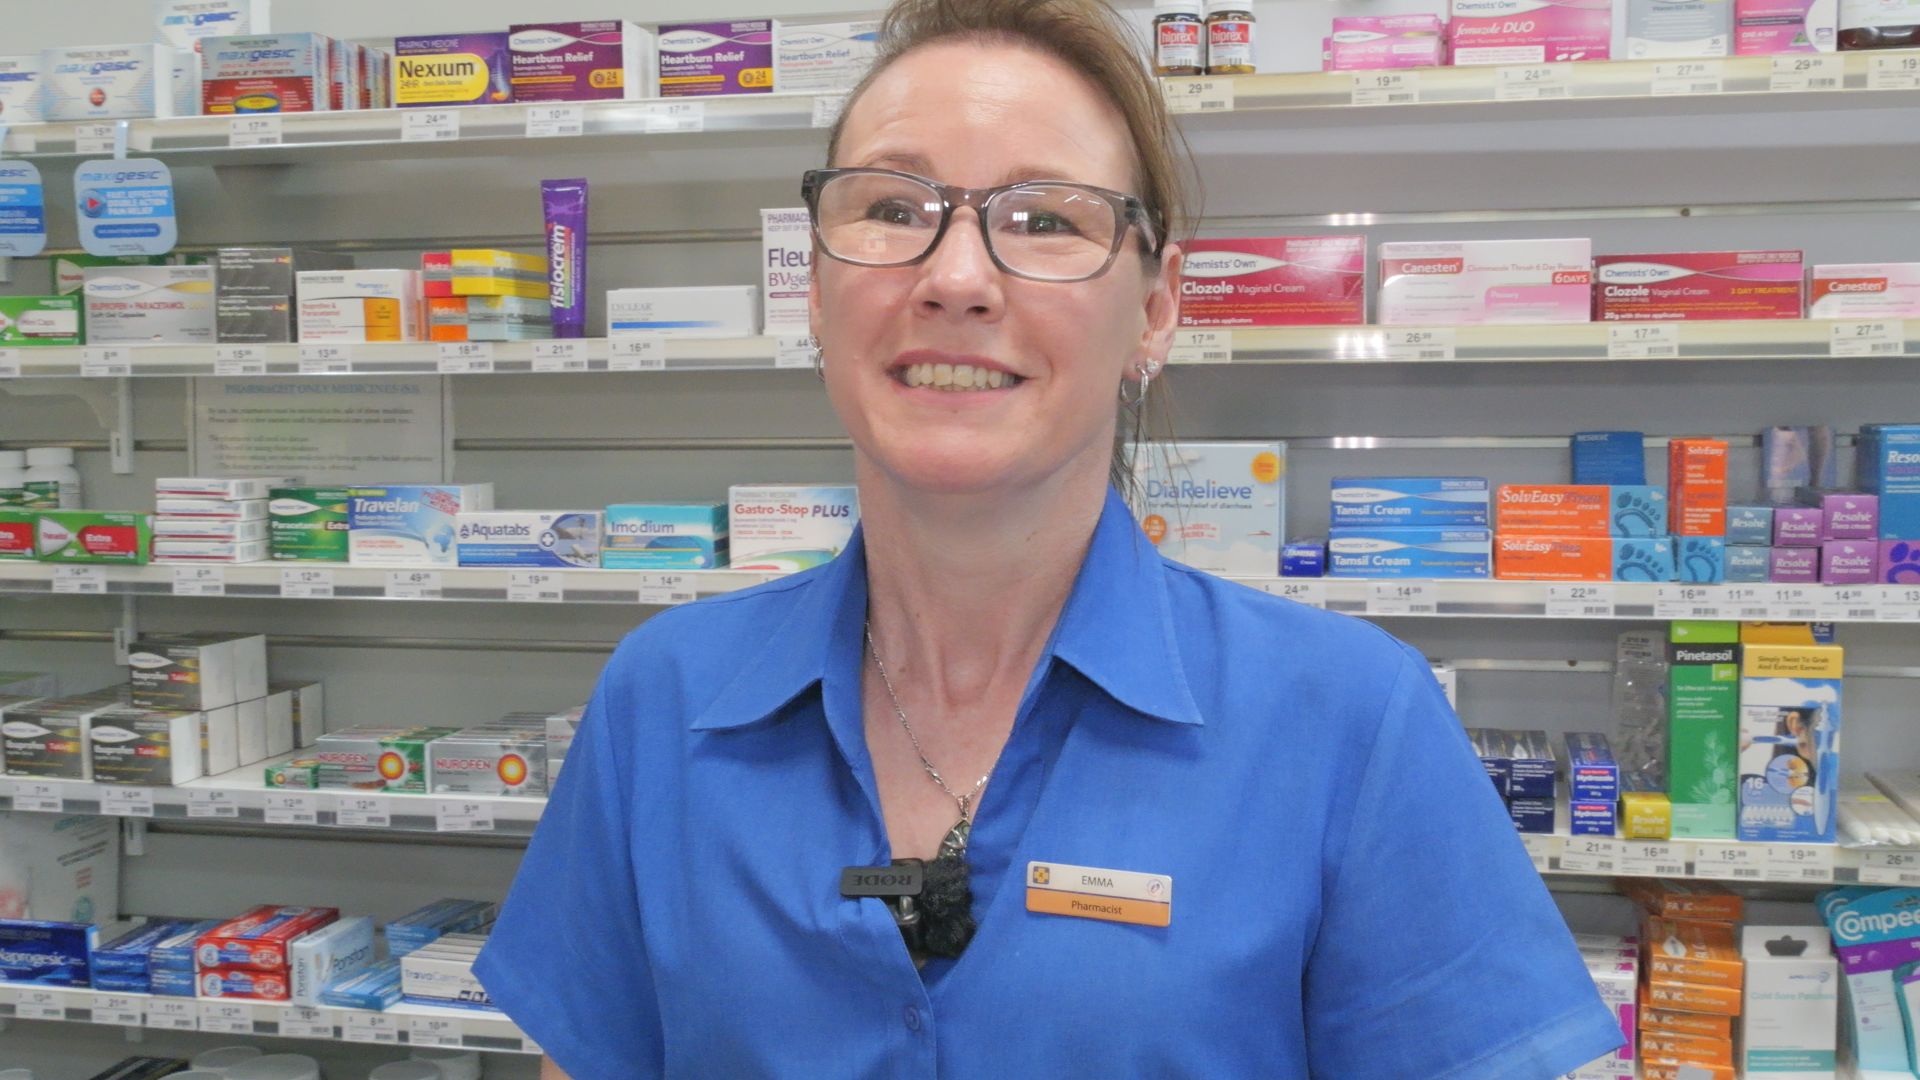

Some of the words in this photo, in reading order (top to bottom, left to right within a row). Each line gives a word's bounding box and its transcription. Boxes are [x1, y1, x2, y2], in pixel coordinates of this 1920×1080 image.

[1456, 1, 1496, 11] Chemists'
[1497, 1, 1518, 9] Own
[1503, 20, 1536, 34] DUO
[1161, 31, 1192, 45] hiprex
[1211, 31, 1243, 44] hiprex
[216, 49, 297, 62] maxigesic
[512, 53, 564, 65] Heartburn
[564, 51, 595, 63] Relief
[661, 53, 713, 65] Heartburn
[714, 50, 745, 63] Relief
[780, 52, 824, 62] Heartburn
[825, 49, 850, 58] Relief
[399, 60, 475, 78] Nexium
[80, 171, 162, 184] maxigesic
[551, 224, 566, 309] fisiocrem
[1184, 258, 1234, 270] Chemists'
[1234, 258, 1257, 268] Own
[1401, 262, 1457, 274] Canesten
[1604, 268, 1648, 278] Chemists'
[1649, 268, 1671, 277] Own
[1181, 280, 1234, 295] Clozole
[1236, 284, 1272, 296] Vaginal
[1273, 282, 1305, 293] Cream
[1604, 286, 1650, 297] Clozole
[1651, 289, 1681, 299] Vaginal
[1682, 287, 1710, 296] Cream
[1736, 287, 1753, 295] DAY
[1754, 286, 1798, 295] TREATMENT
[1828, 281, 1882, 293] Canesten
[1687, 447, 1724, 457] SolvEasy
[1146, 479, 1253, 501] DiaRelieve
[1501, 489, 1565, 506] SolvEasy
[354, 496, 420, 513] Travelan
[734, 503, 809, 518] Gastro-Stop
[811, 504, 850, 518] PLUS
[1335, 505, 1370, 516] Tamsil
[1373, 505, 1411, 515] Cream
[1831, 511, 1872, 522] Resolve
[271, 520, 323, 530] Paracetamol
[326, 521, 350, 531] Extra
[610, 521, 675, 534] Imodium
[1731, 518, 1767, 529] Resolve
[1780, 521, 1817, 531] Resolve
[471, 522, 530, 541] Aquatabs
[1501, 539, 1552, 554] SolvEasy
[1333, 555, 1369, 566] Tamsil
[1372, 555, 1411, 566] Cream
[1730, 556, 1764, 566] Resolve
[1775, 558, 1812, 568] Resolve
[1830, 555, 1872, 566] Resolve
[1676, 650, 1733, 662] Pinetarsol
[1757, 663, 1772, 671] And
[318, 753, 369, 764] NUROFEN
[435, 759, 492, 771] NUROFEN
[1745, 777, 1765, 790] 16
[1080, 875, 1114, 889] EMMA
[1071, 900, 1123, 916] Pharmacist
[1751, 992, 1777, 1000] Cold
[1778, 992, 1796, 1000] Sore
